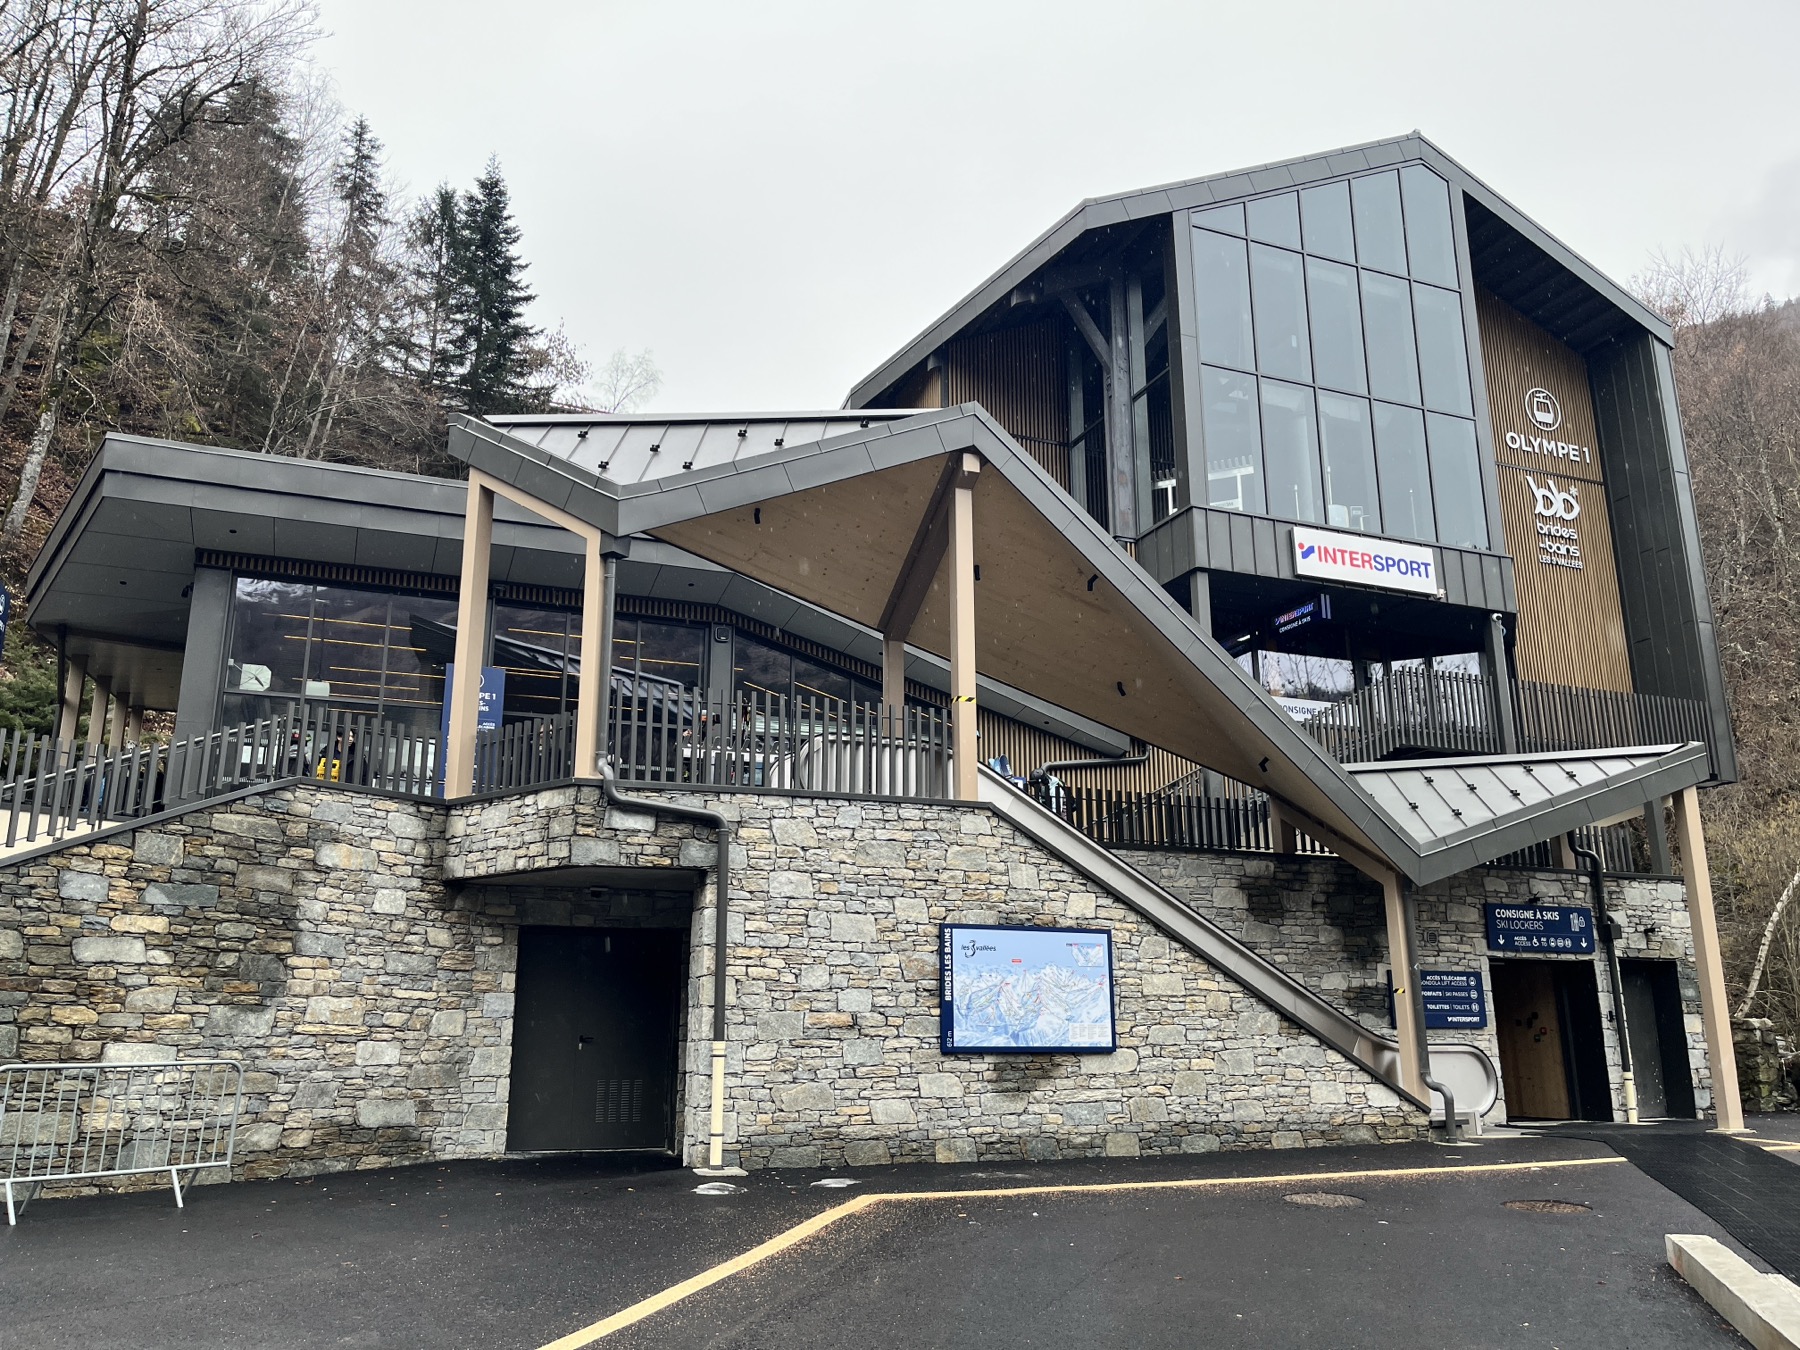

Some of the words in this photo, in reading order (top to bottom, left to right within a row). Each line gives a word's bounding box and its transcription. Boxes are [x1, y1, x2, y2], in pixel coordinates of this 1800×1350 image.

[1506, 432, 1580, 462] OLYMPE
[1583, 447, 1591, 464] 1
[1536, 519, 1578, 539] brides
[1545, 537, 1580, 556] bains
[1317, 545, 1432, 579] INTERSPORT
[1539, 555, 1551, 564] LES
[1279, 602, 1314, 624] INTERSPORT
[1495, 908, 1535, 920] CONSIGNE
[1536, 908, 1542, 920] À
[1542, 911, 1560, 921] SKIS
[1496, 919, 1508, 929] SKI
[1510, 920, 1544, 930] LOCKERS
[944, 927, 952, 953] BAINS
[964, 939, 976, 958] 3
[944, 954, 952, 969] LES
